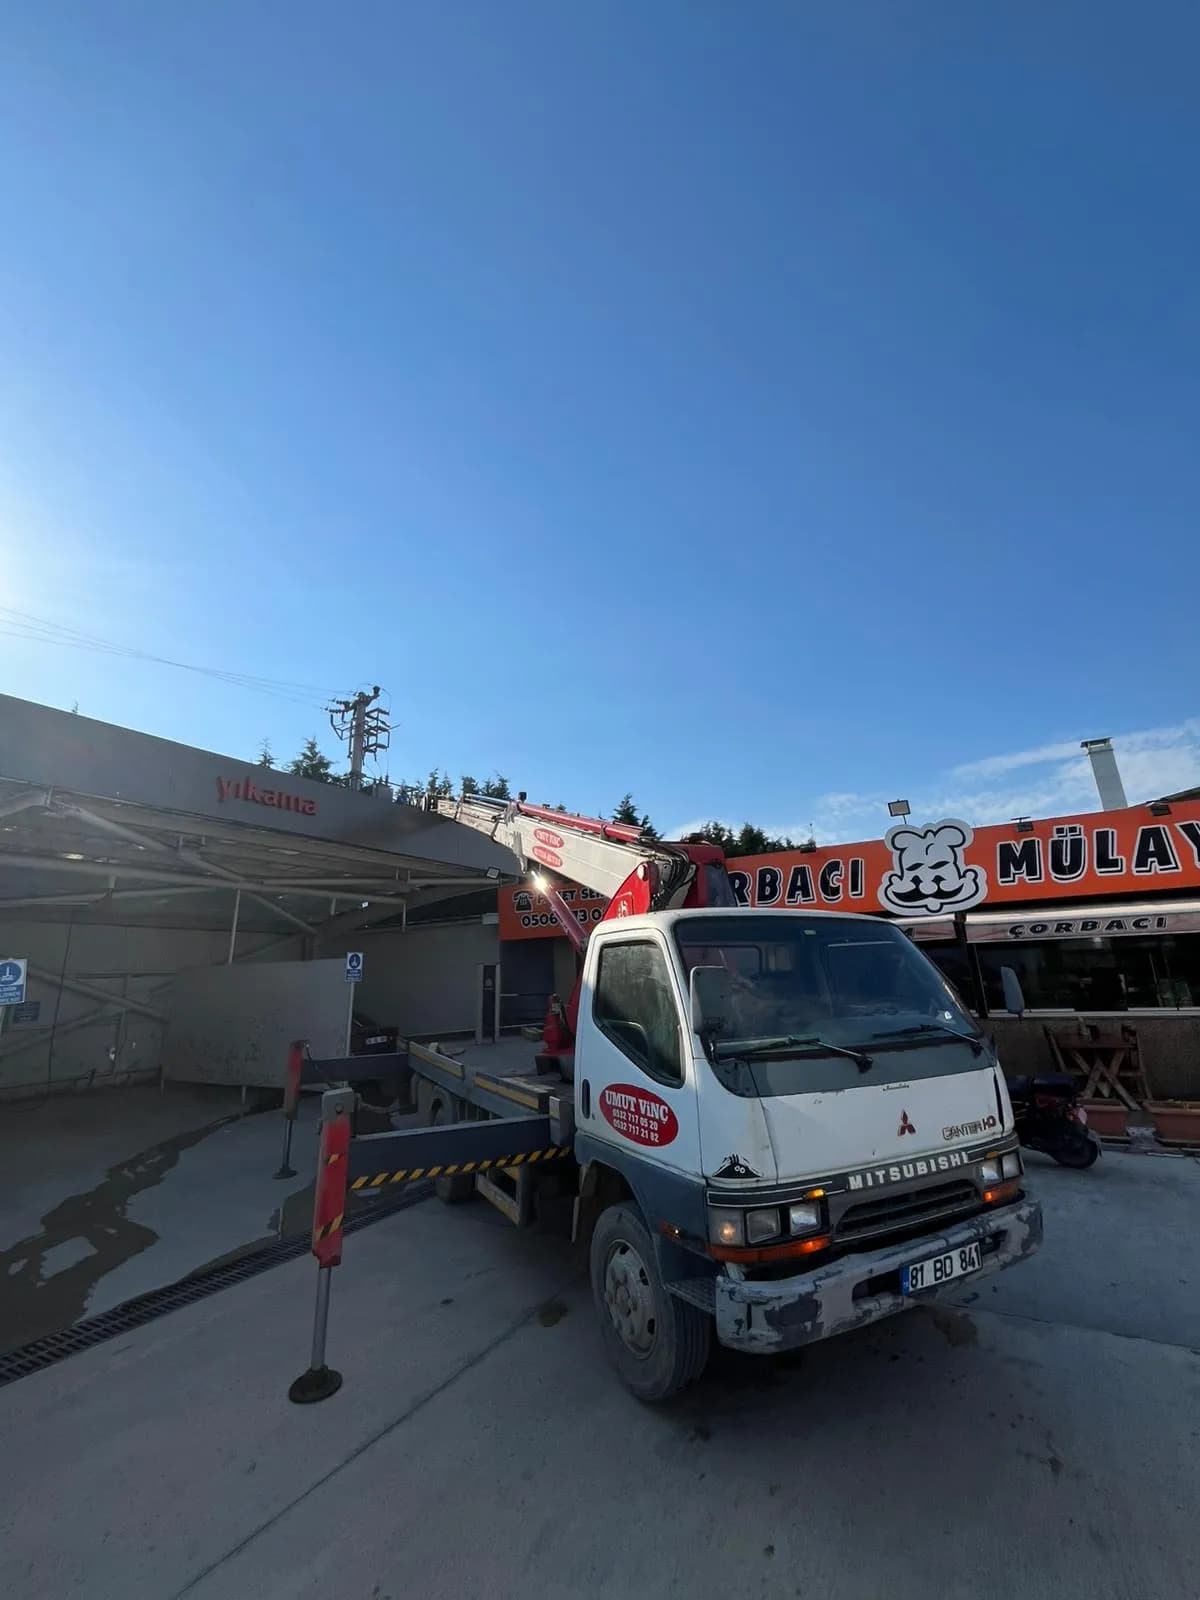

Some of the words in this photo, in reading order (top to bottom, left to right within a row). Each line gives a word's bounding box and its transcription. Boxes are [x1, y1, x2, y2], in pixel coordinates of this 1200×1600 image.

[522, 913, 558, 927] 0506
[1008, 915, 1167, 939] ÇORBACI
[605, 1090, 636, 1112] UMUT
[612, 1108, 627, 1121] 0532
[627, 1112, 639, 1124] 717
[649, 1120, 658, 1132] 20
[613, 1118, 628, 1132] 0532
[628, 1122, 640, 1136] 717
[640, 1127, 649, 1139] 21
[848, 1151, 968, 1190] MITSUBISHI
[910, 1263, 925, 1289] 81
[933, 1254, 954, 1282] BD
[959, 1244, 981, 1272] 841
